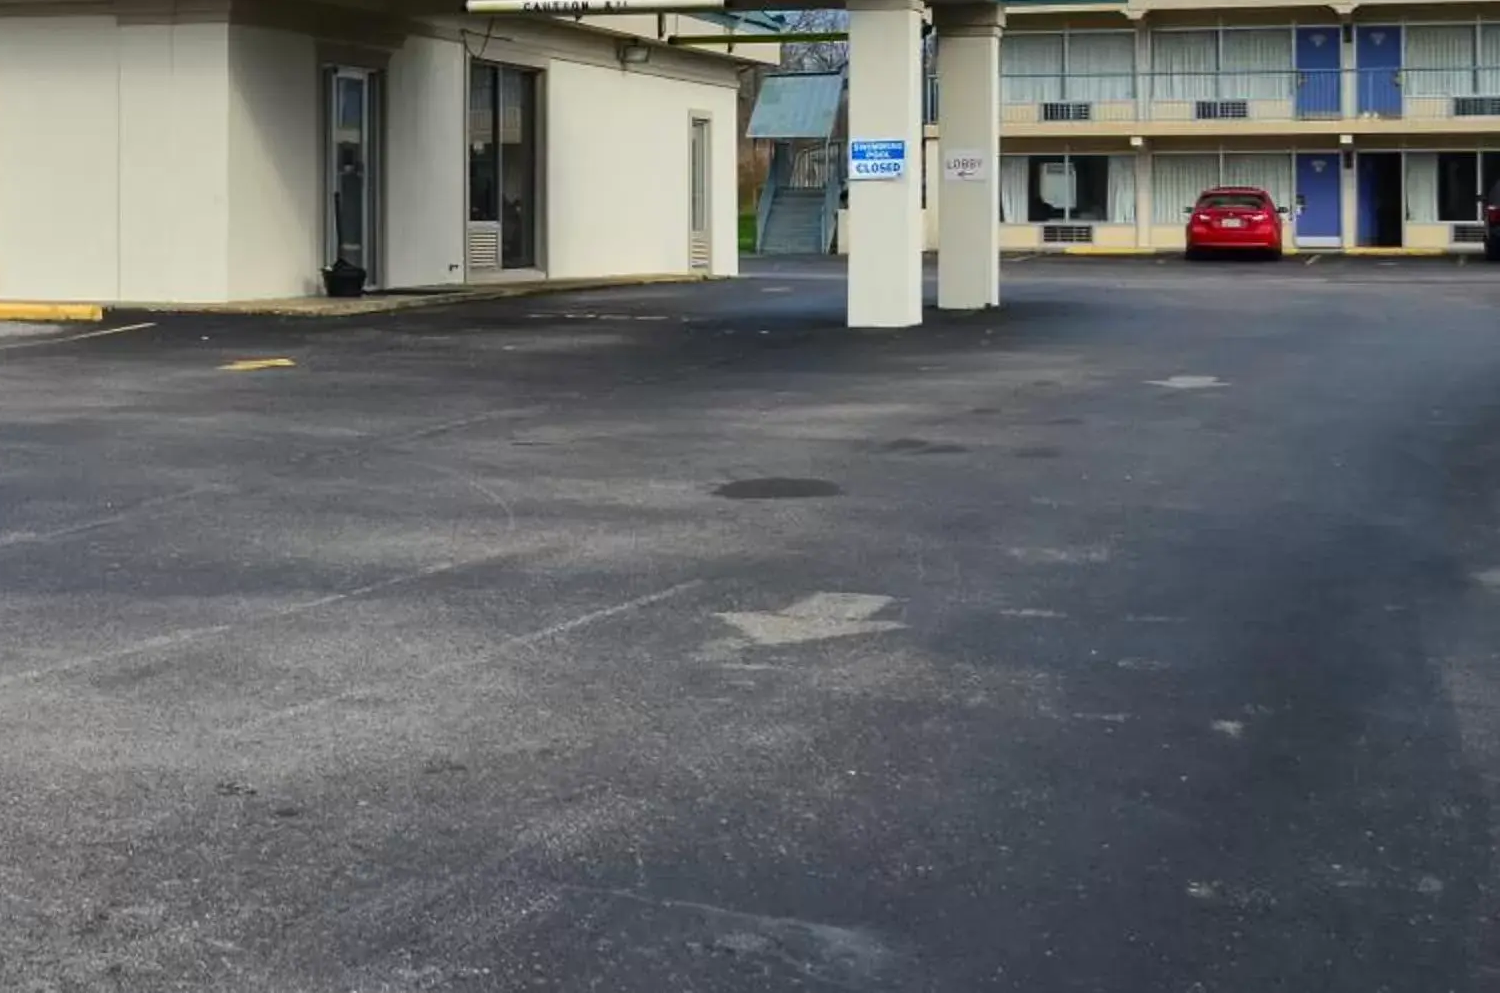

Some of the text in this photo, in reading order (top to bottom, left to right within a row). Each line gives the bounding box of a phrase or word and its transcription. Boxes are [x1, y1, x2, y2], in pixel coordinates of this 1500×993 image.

[523, 0, 590, 12] CAUTION
[856, 162, 901, 174] CLOSED
[946, 158, 983, 170] LOBBY
